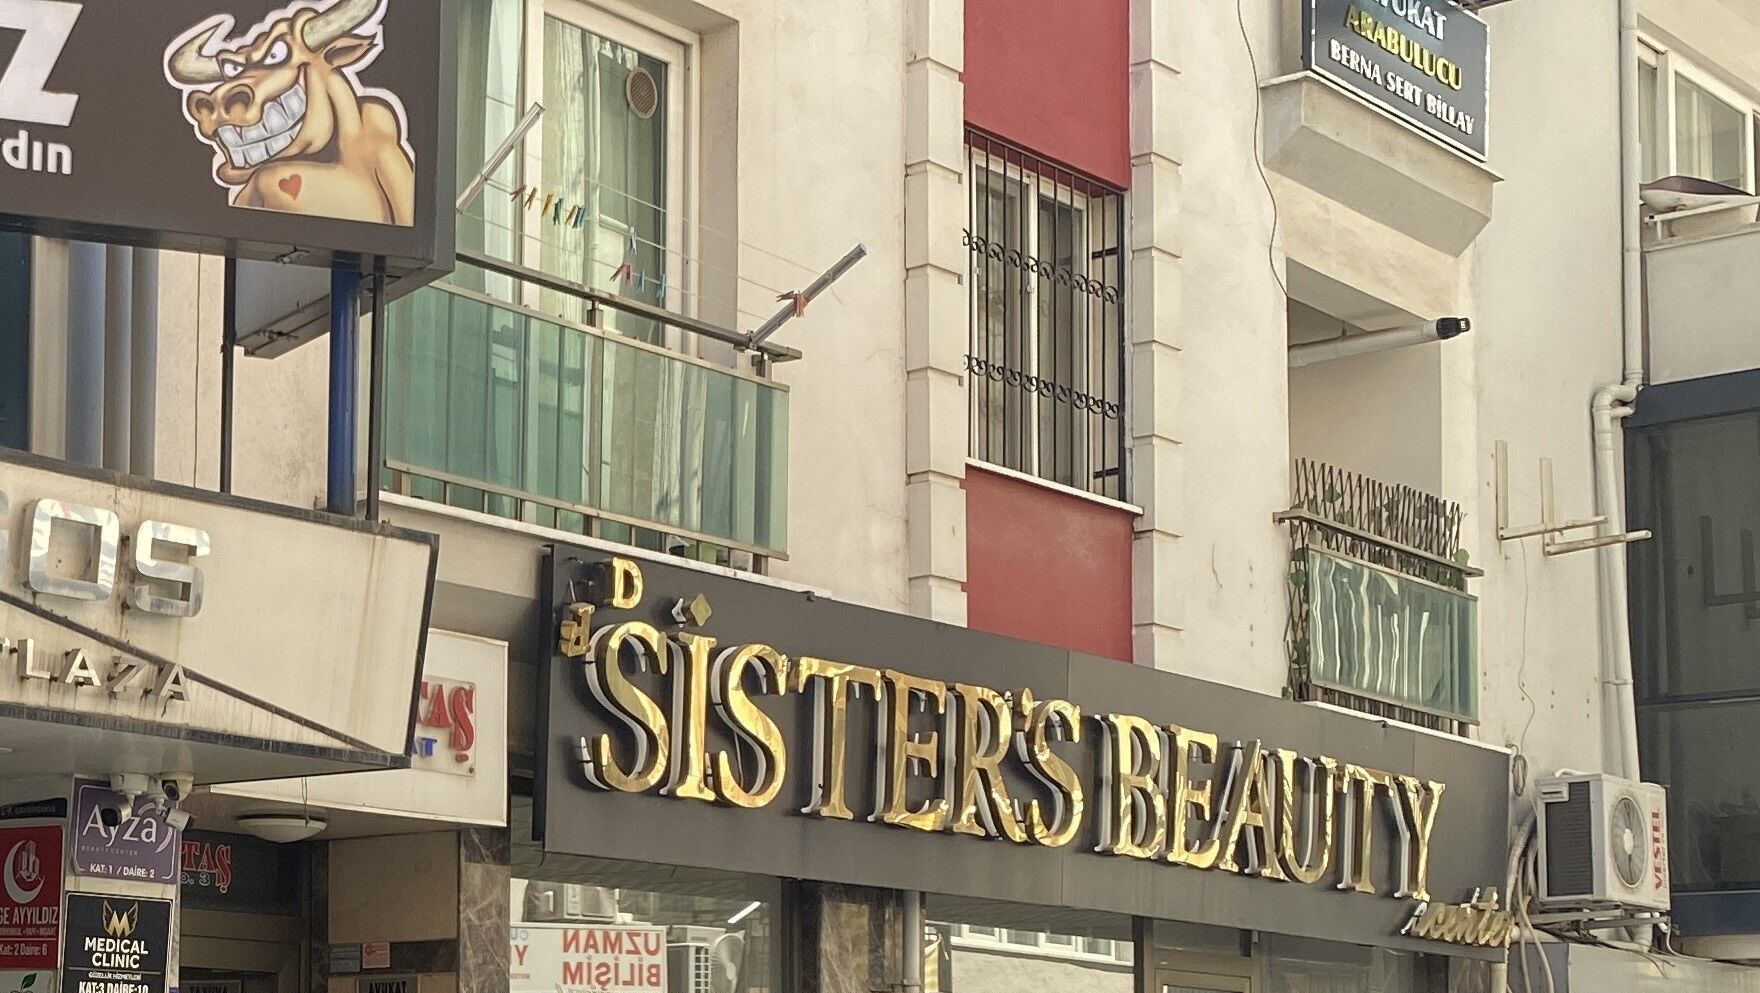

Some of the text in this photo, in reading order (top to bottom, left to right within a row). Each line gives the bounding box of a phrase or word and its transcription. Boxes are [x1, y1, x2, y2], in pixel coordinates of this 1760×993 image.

[1345, 5, 1462, 90] ARABULUCU
[1329, 38, 1382, 86] BERNA
[1387, 71, 1422, 106] SERT
[1096, 712, 1446, 902] BEAUTY
[12, 906, 58, 924] AYYILDIZ
[84, 936, 149, 955] MEDICAL
[92, 953, 140, 969] CLINIC
